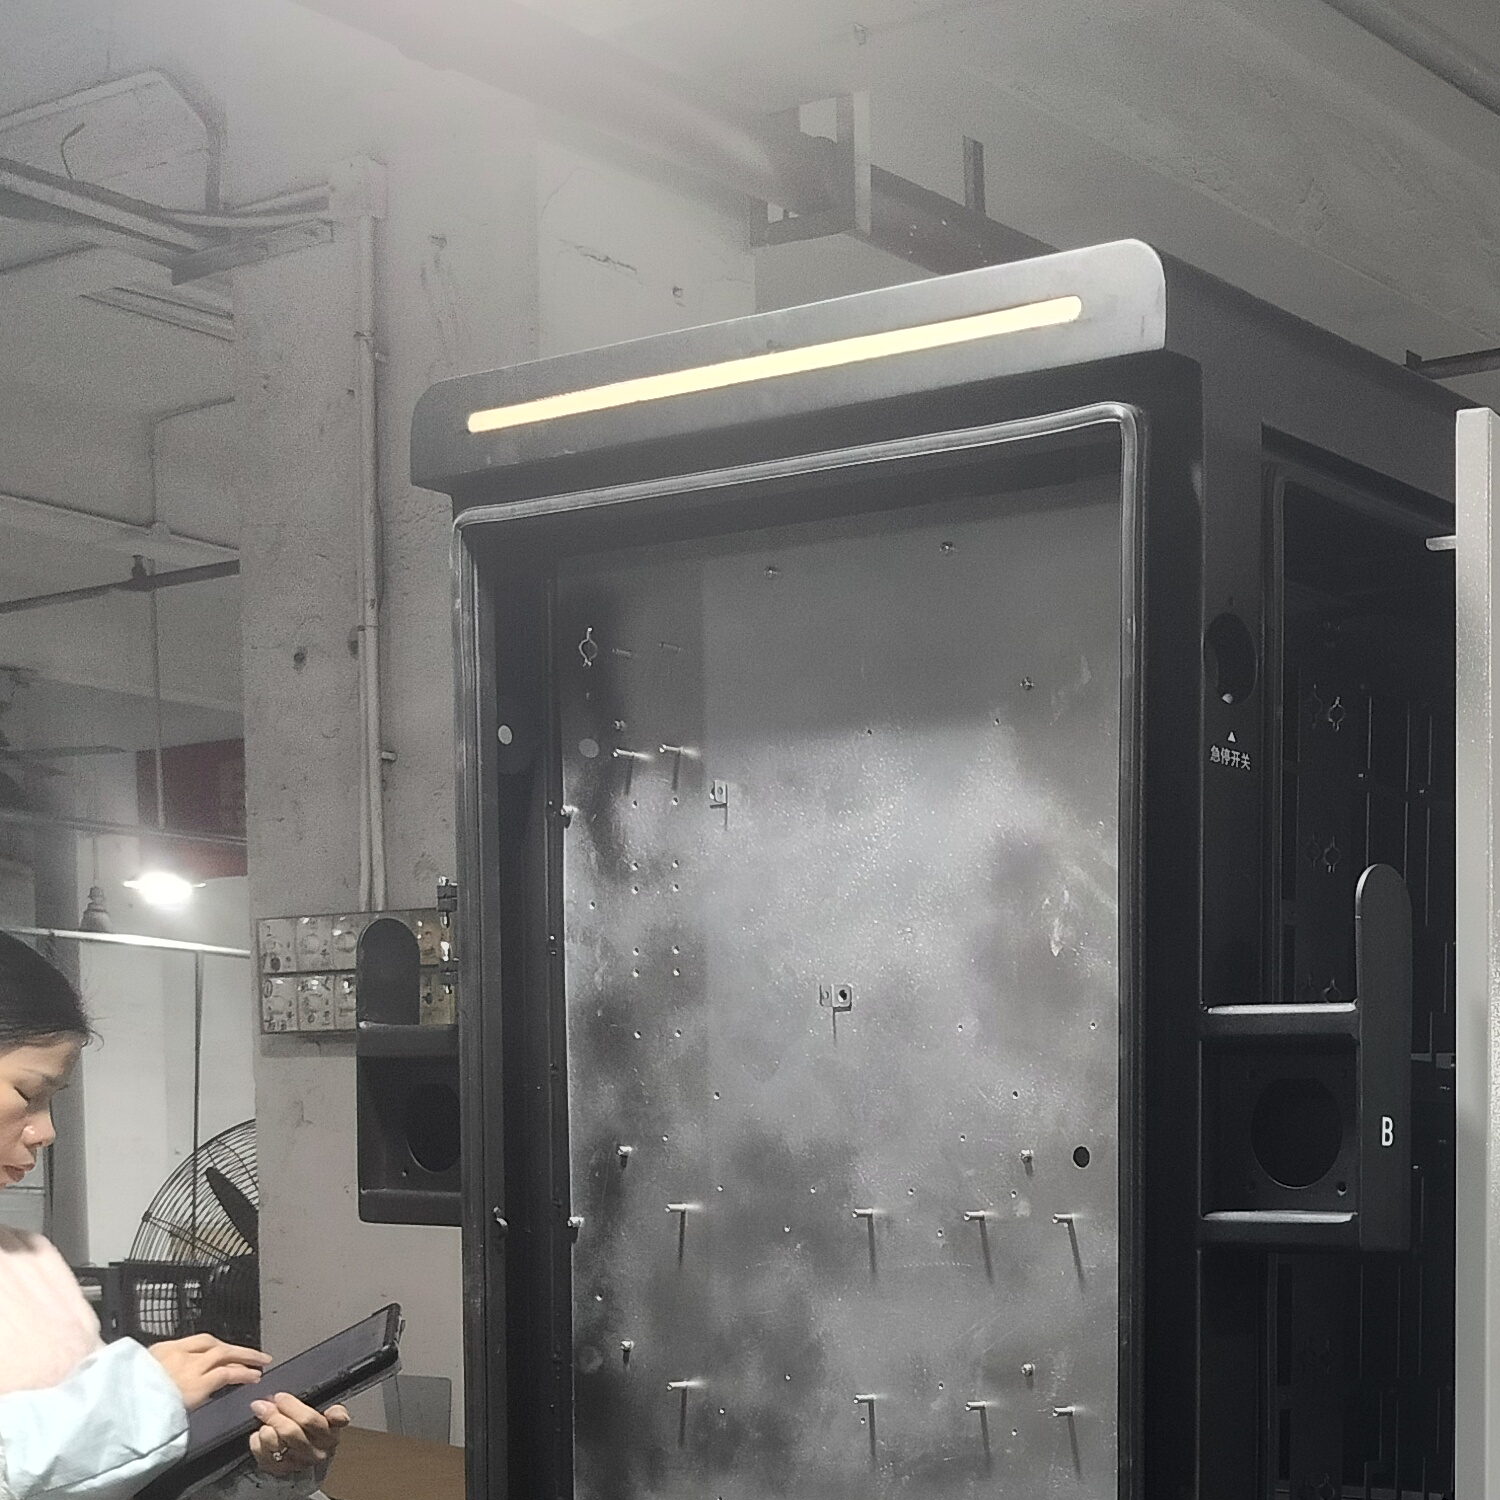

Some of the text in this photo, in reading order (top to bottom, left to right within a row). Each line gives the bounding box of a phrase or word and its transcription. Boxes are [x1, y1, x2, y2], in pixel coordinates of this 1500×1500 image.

[1210, 745, 1251, 771] 急停开关
[1381, 1116, 1394, 1147] B
